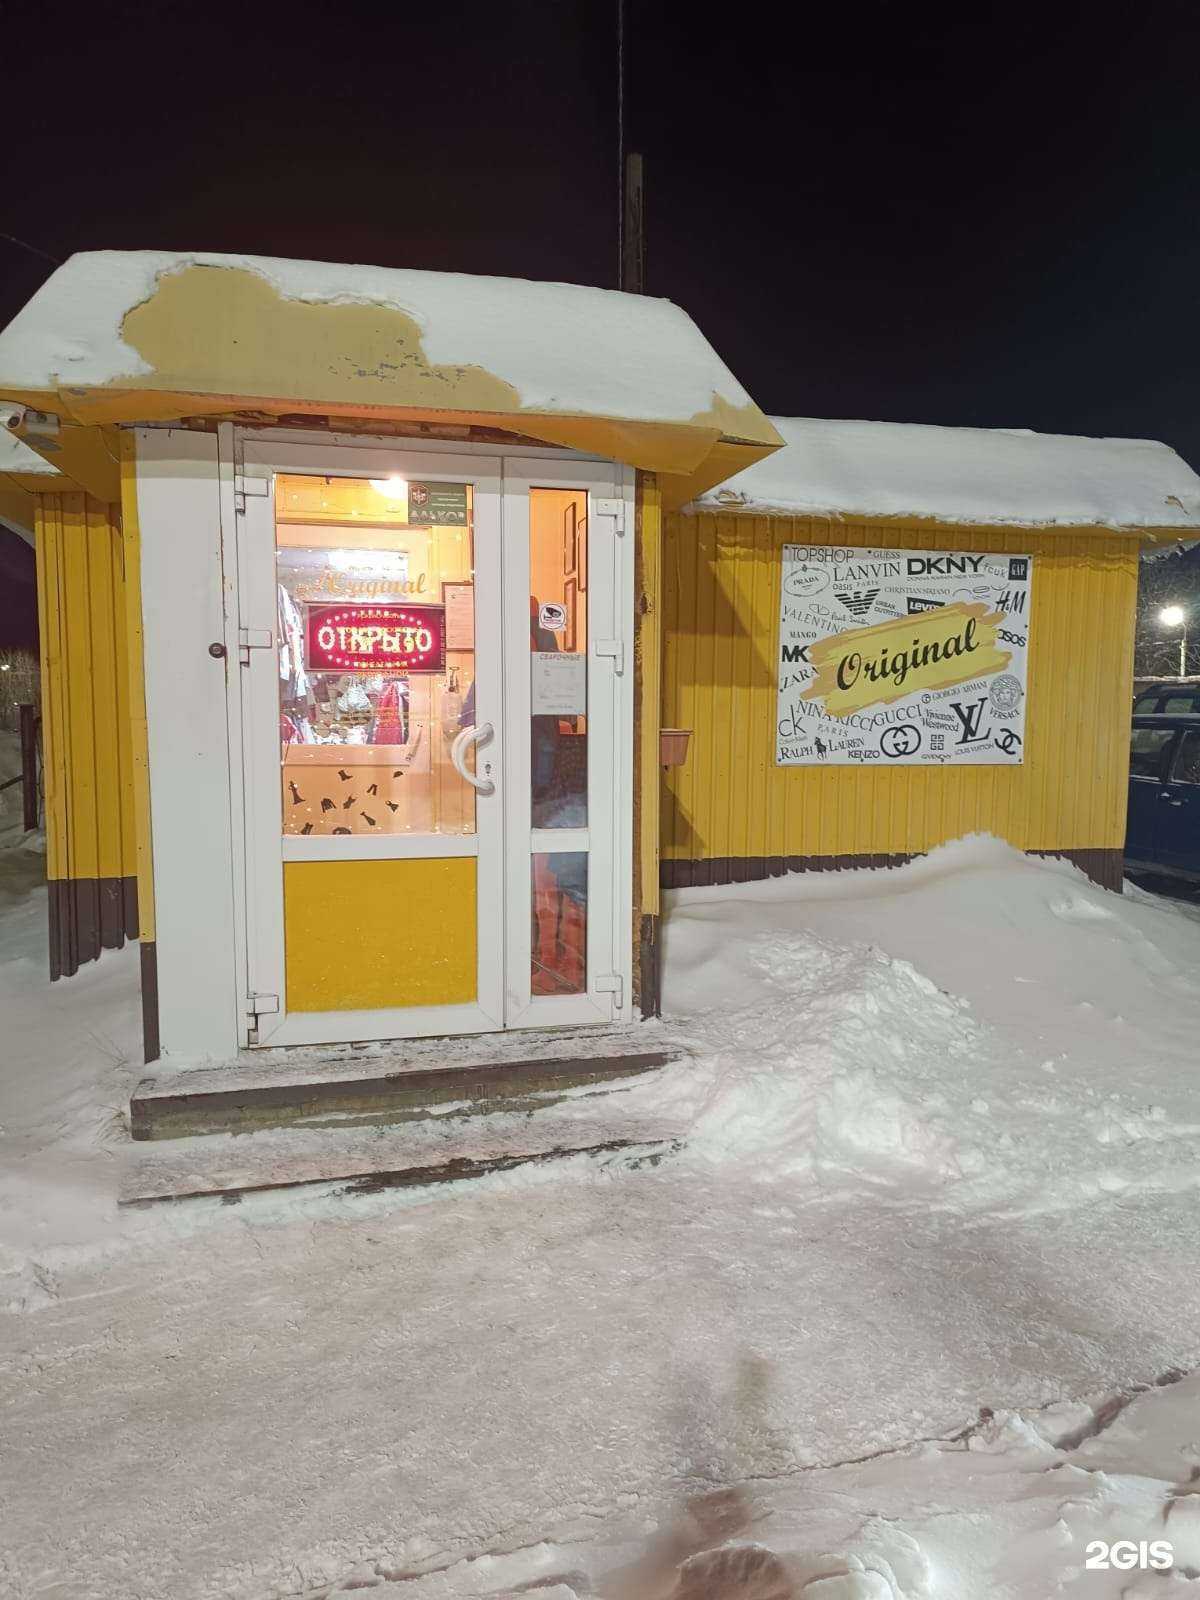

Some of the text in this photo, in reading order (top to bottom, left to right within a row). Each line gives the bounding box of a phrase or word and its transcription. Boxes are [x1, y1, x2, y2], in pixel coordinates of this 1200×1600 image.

[791, 547, 855, 563] TOPSHOP
[873, 550, 902, 559] GUESS
[833, 562, 901, 582] LANVIN
[906, 555, 985, 576] DKNY
[1011, 563, 1025, 576] GAP
[793, 576, 820, 586] PRADA
[884, 586, 923, 594] CHRISTIAN
[995, 590, 1027, 614] H&M
[317, 625, 433, 653] ОТКРЫТО
[790, 631, 817, 639] MANGO
[781, 645, 809, 662] MK
[836, 617, 980, 691] Original
[873, 704, 922, 727] GUCCI
[989, 706, 1020, 720] VERSACE
[818, 723, 848, 737] PARIS
[921, 718, 960, 733] Westwood
[848, 750, 880, 759] KENZO
